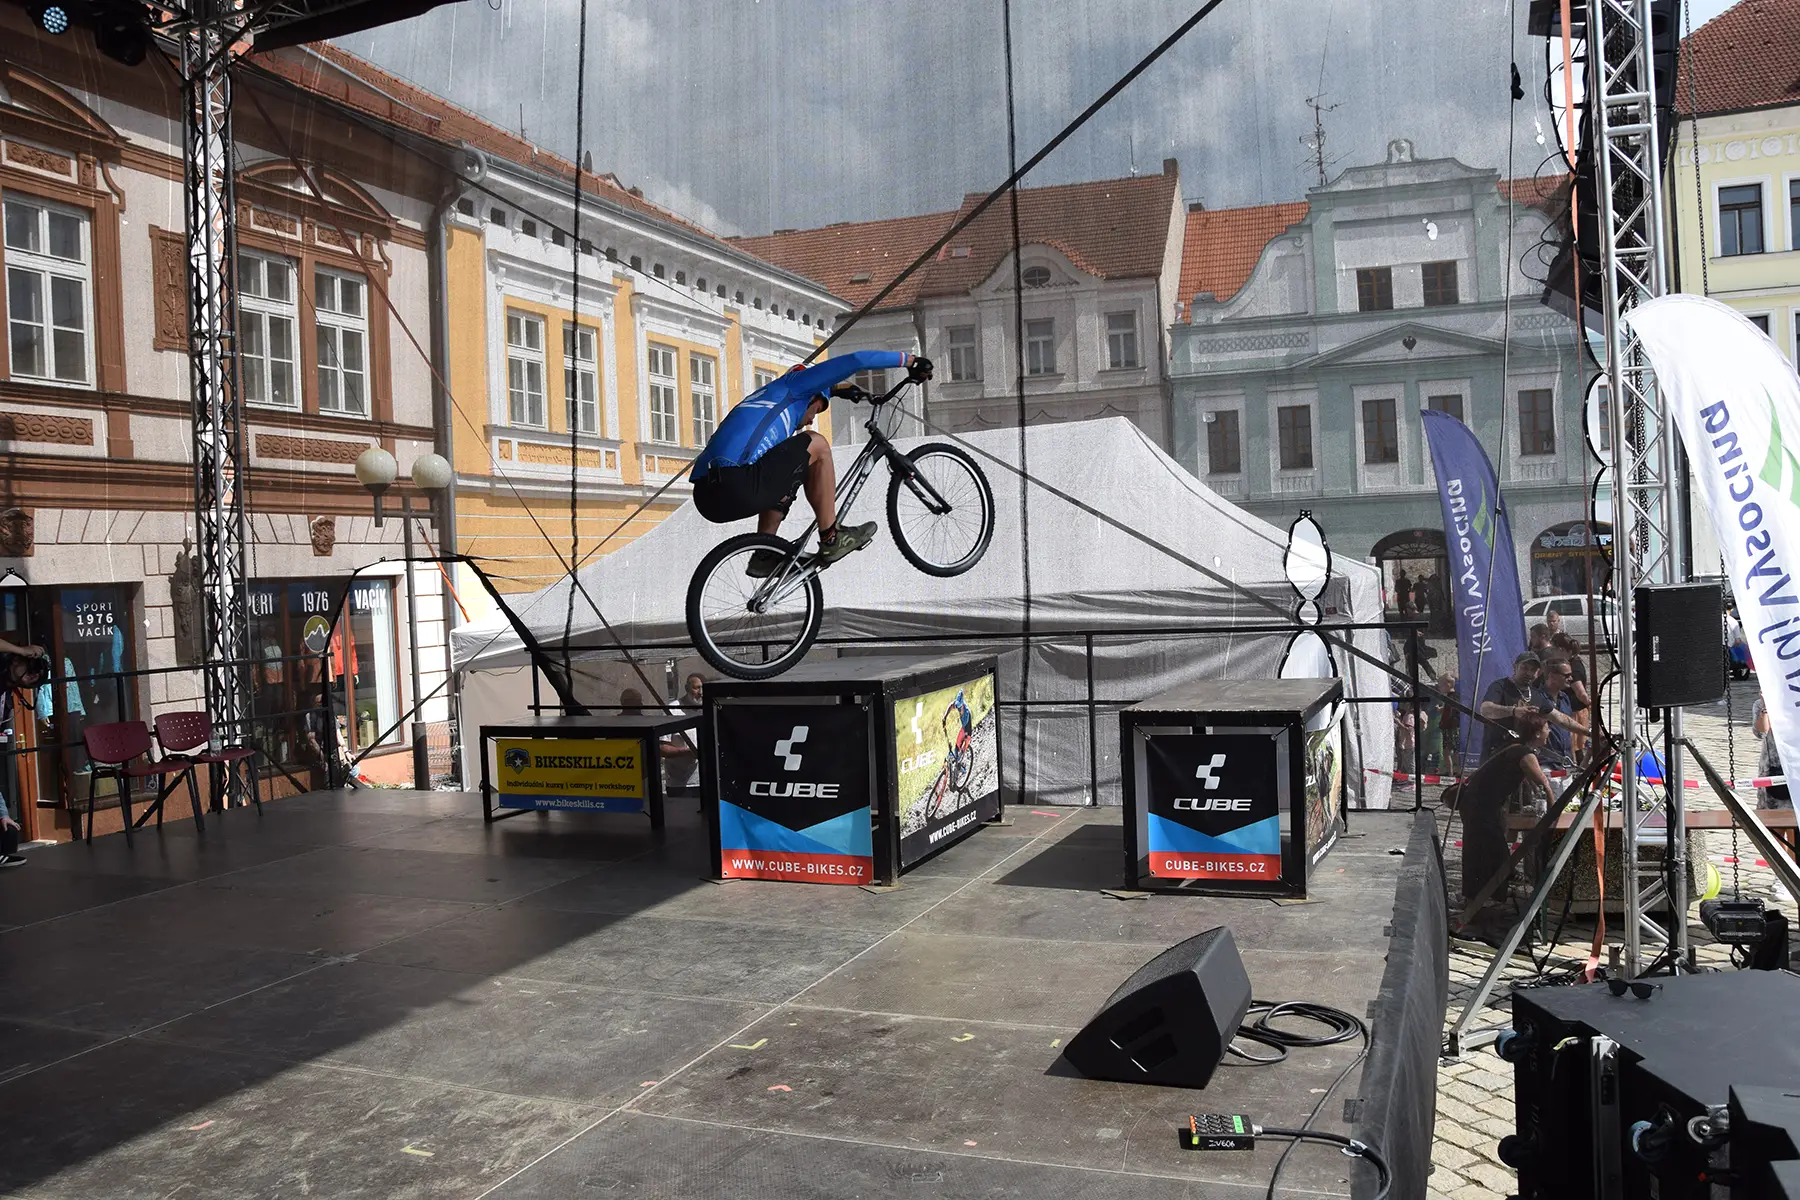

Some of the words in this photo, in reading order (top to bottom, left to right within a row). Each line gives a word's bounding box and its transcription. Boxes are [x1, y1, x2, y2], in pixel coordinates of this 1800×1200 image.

[301, 591, 329, 612] 1976
[354, 583, 387, 609] VACÍK
[76, 602, 112, 612] SPORT
[77, 613, 113, 625] 1976
[78, 625, 113, 637] VACÍK
[535, 756, 635, 769] BIKESKILLS.CZ
[902, 749, 936, 773] CUBE
[569, 782, 593, 791] campy
[598, 784, 635, 792] workshopy
[750, 781, 840, 798] CUBE
[535, 799, 605, 809] www.bikeskills.cz
[1173, 798, 1252, 811] CUBE
[929, 810, 977, 844] WWW.CUBE-BIKES.CZ
[732, 859, 864, 876] WWW.CUBE-BIKES.CZ
[1165, 860, 1265, 873] CUBE-BIKES.CZ
